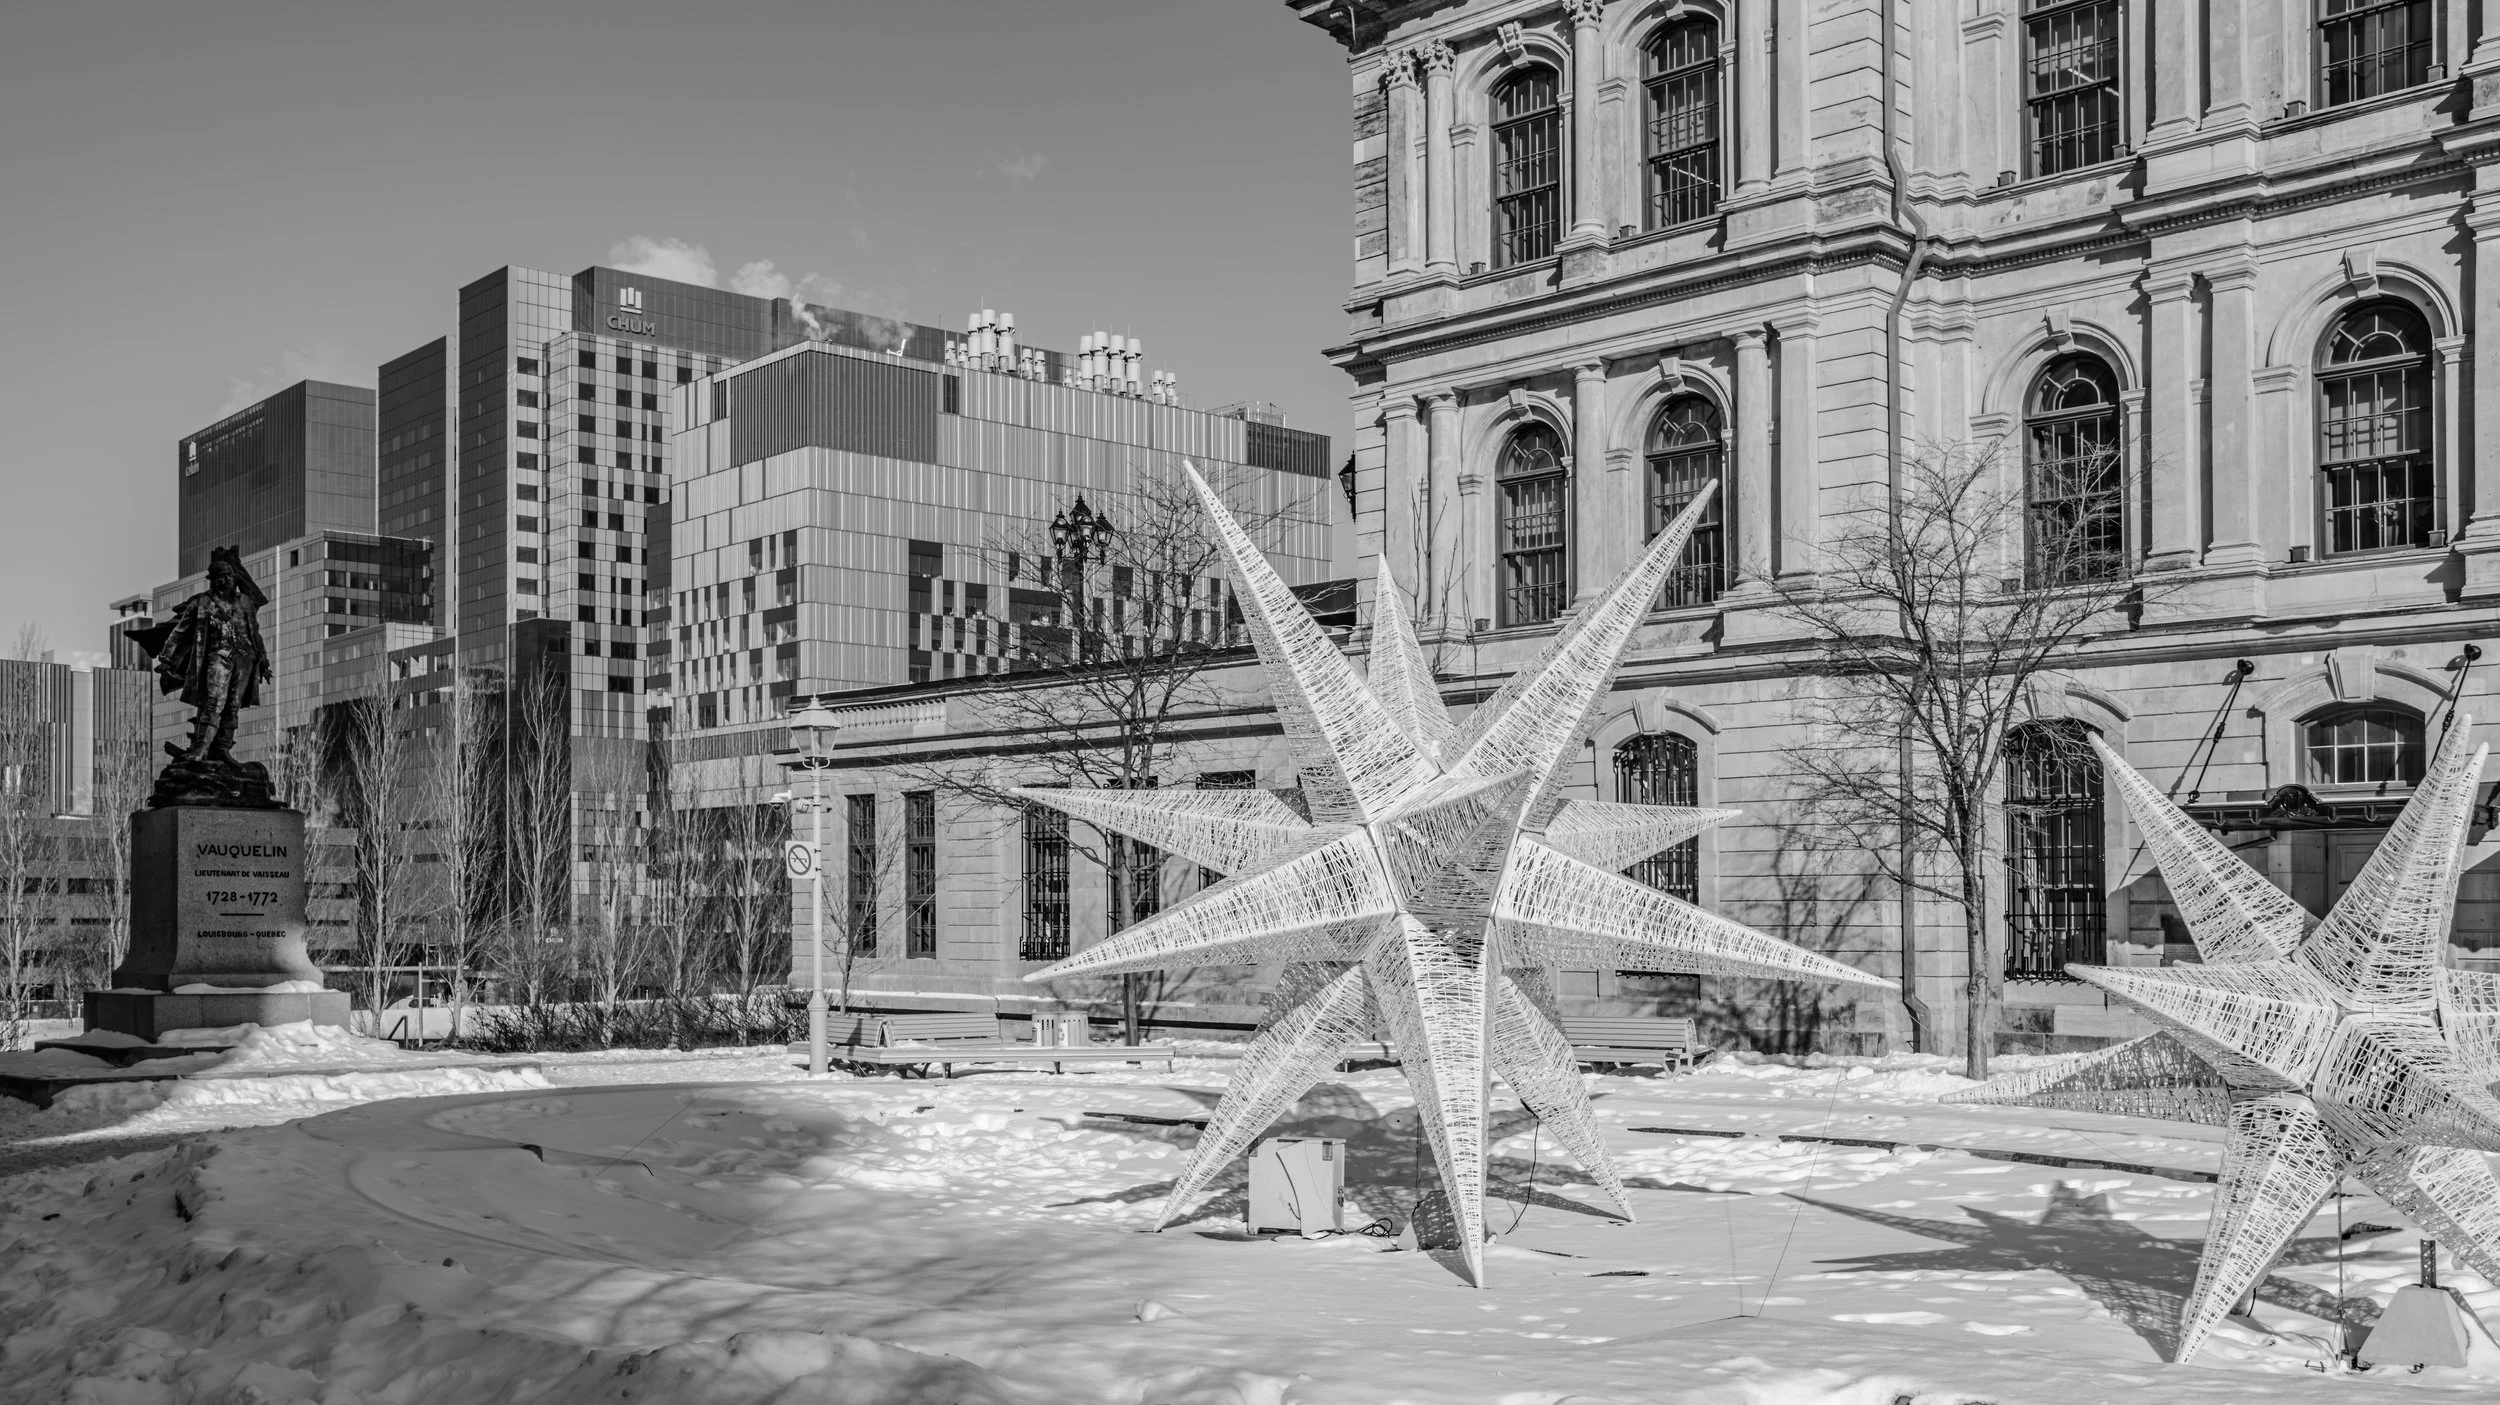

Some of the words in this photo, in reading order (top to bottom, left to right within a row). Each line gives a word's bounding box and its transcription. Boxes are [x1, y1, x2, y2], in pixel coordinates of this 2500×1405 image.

[606, 315, 655, 337] CHUM
[197, 844, 287, 859] VAUQUELIN
[194, 869, 240, 877] LIEUTENANT
